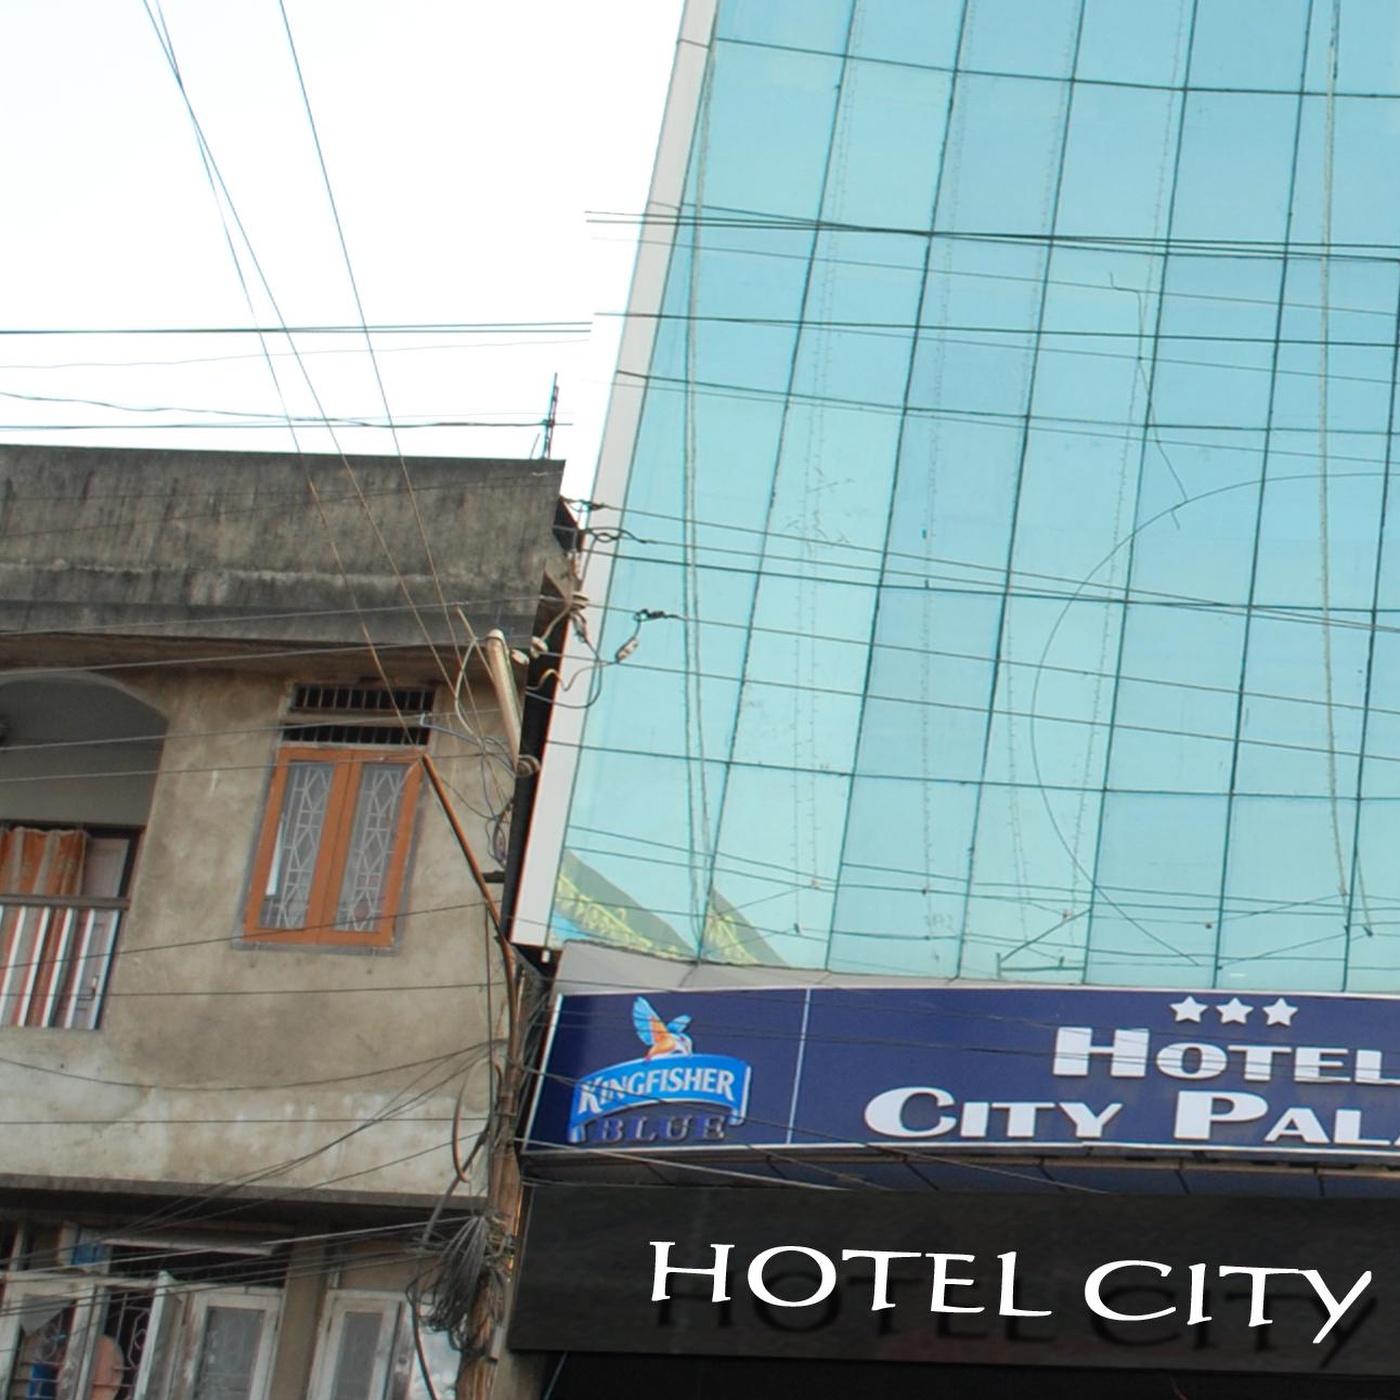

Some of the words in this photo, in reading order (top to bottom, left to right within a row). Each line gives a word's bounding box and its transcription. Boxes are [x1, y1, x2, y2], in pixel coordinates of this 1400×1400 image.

[577, 1058, 735, 1116] KINGFISHER
[864, 1086, 1124, 1139] CITY
[600, 1114, 727, 1143] BLUE
[649, 1241, 1052, 1319] HOTEL
[1083, 1259, 1373, 1345] CITY
